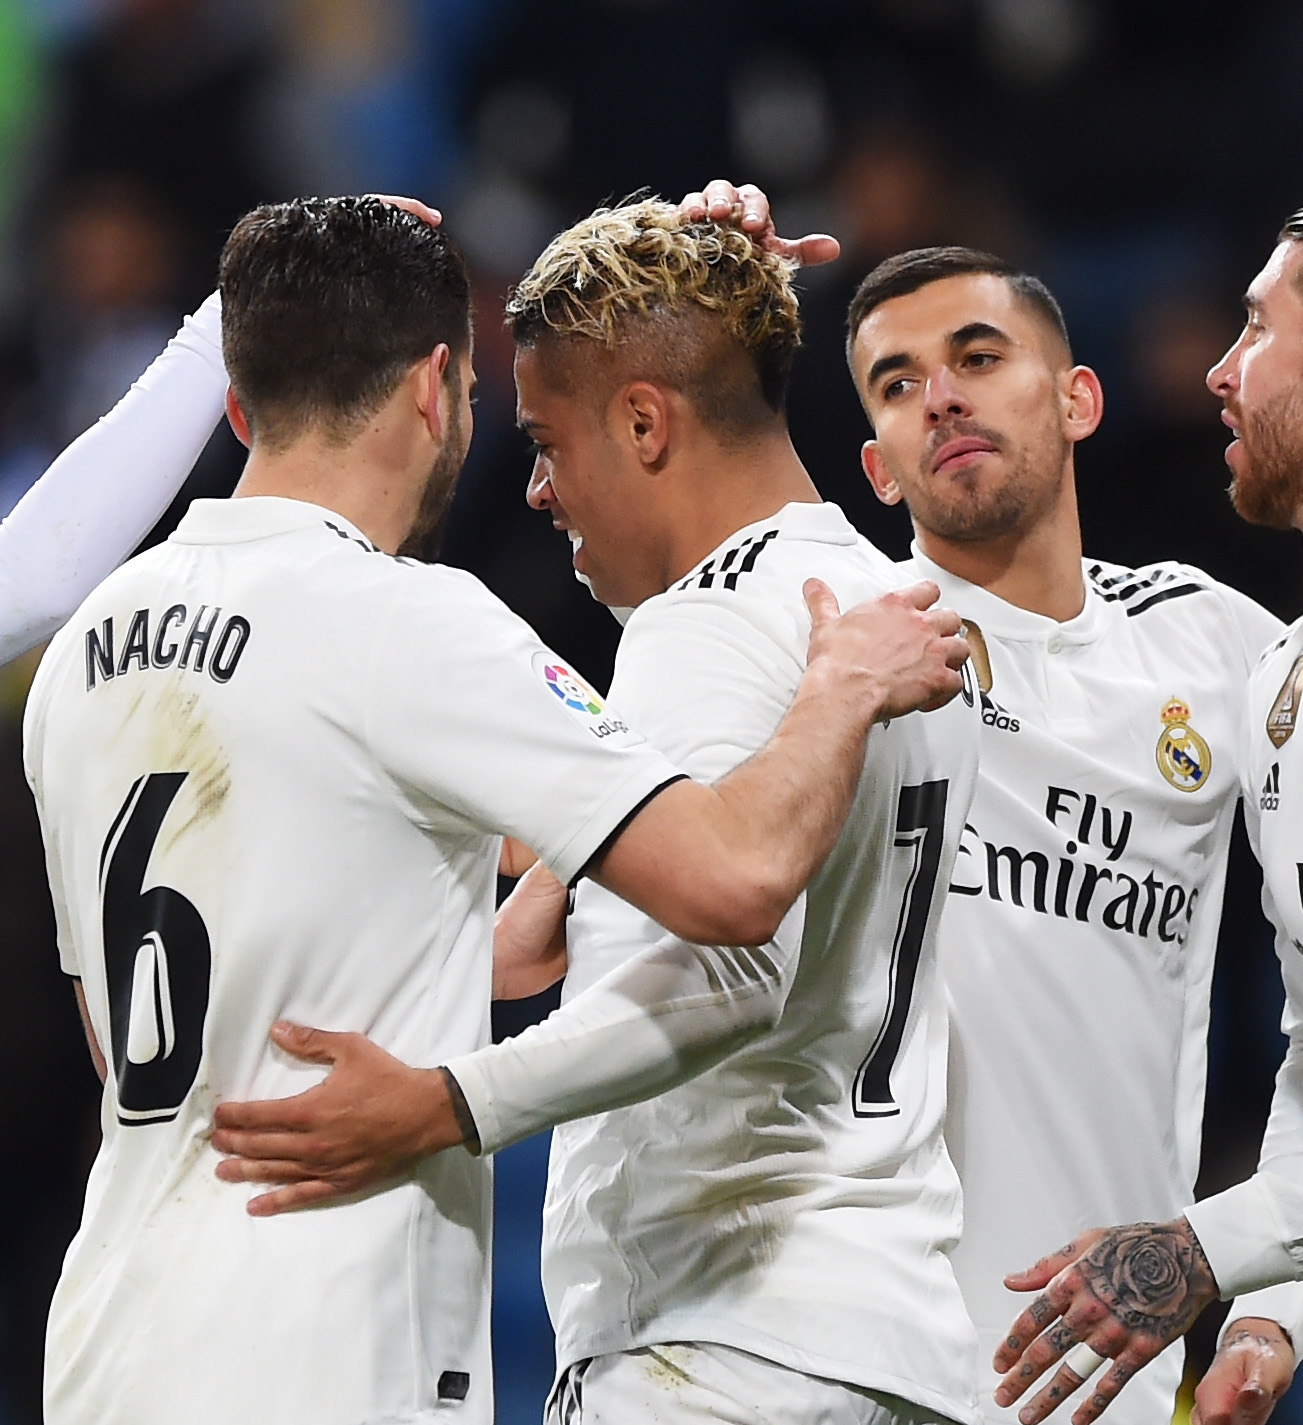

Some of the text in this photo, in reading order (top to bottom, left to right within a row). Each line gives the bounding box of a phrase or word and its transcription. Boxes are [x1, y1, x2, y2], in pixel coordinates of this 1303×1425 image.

[85, 603, 251, 692] NACHO
[1045, 785, 1133, 862] Fly
[98, 771, 212, 1127] 6
[851, 779, 949, 1119] 7
